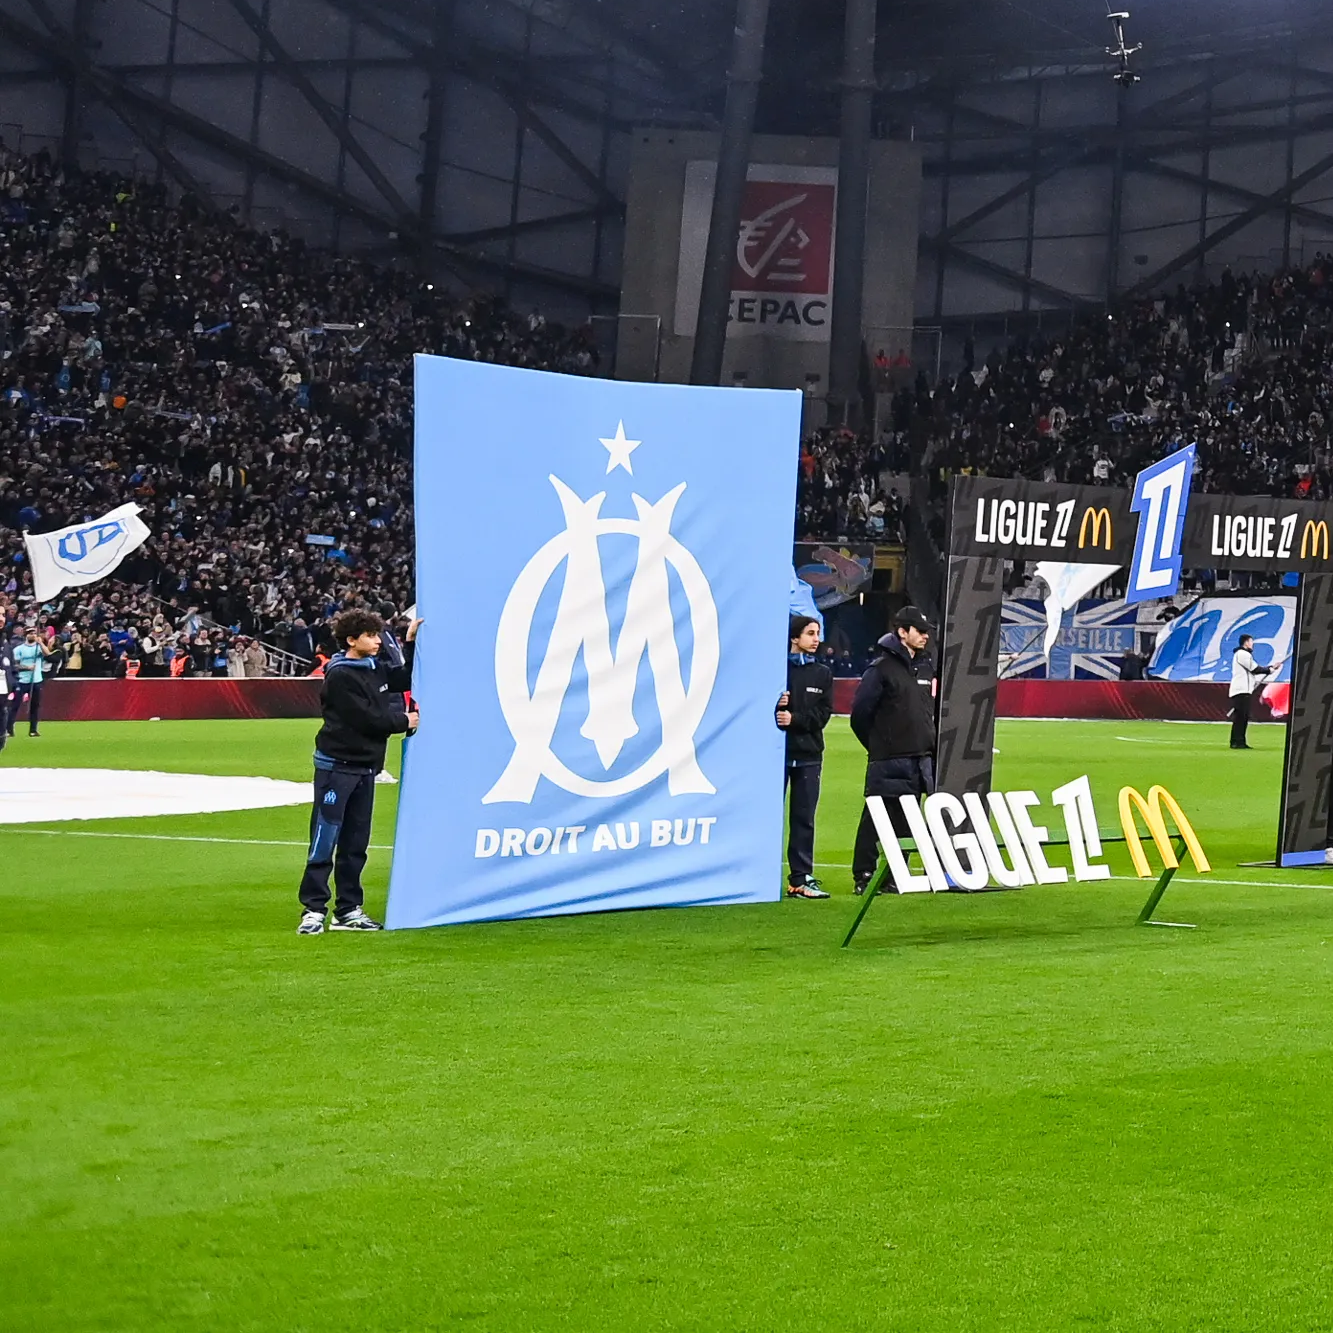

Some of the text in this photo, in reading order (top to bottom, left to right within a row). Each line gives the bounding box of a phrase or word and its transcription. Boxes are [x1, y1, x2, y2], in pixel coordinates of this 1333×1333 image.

[728, 297, 828, 326] EPAC
[975, 497, 1051, 546] LIGUE
[1211, 513, 1275, 558] LIGUE
[1023, 628, 1123, 651] MRSEILLE
[474, 816, 718, 859] DROIT AU BUT
[866, 790, 1069, 895] LIGUE
